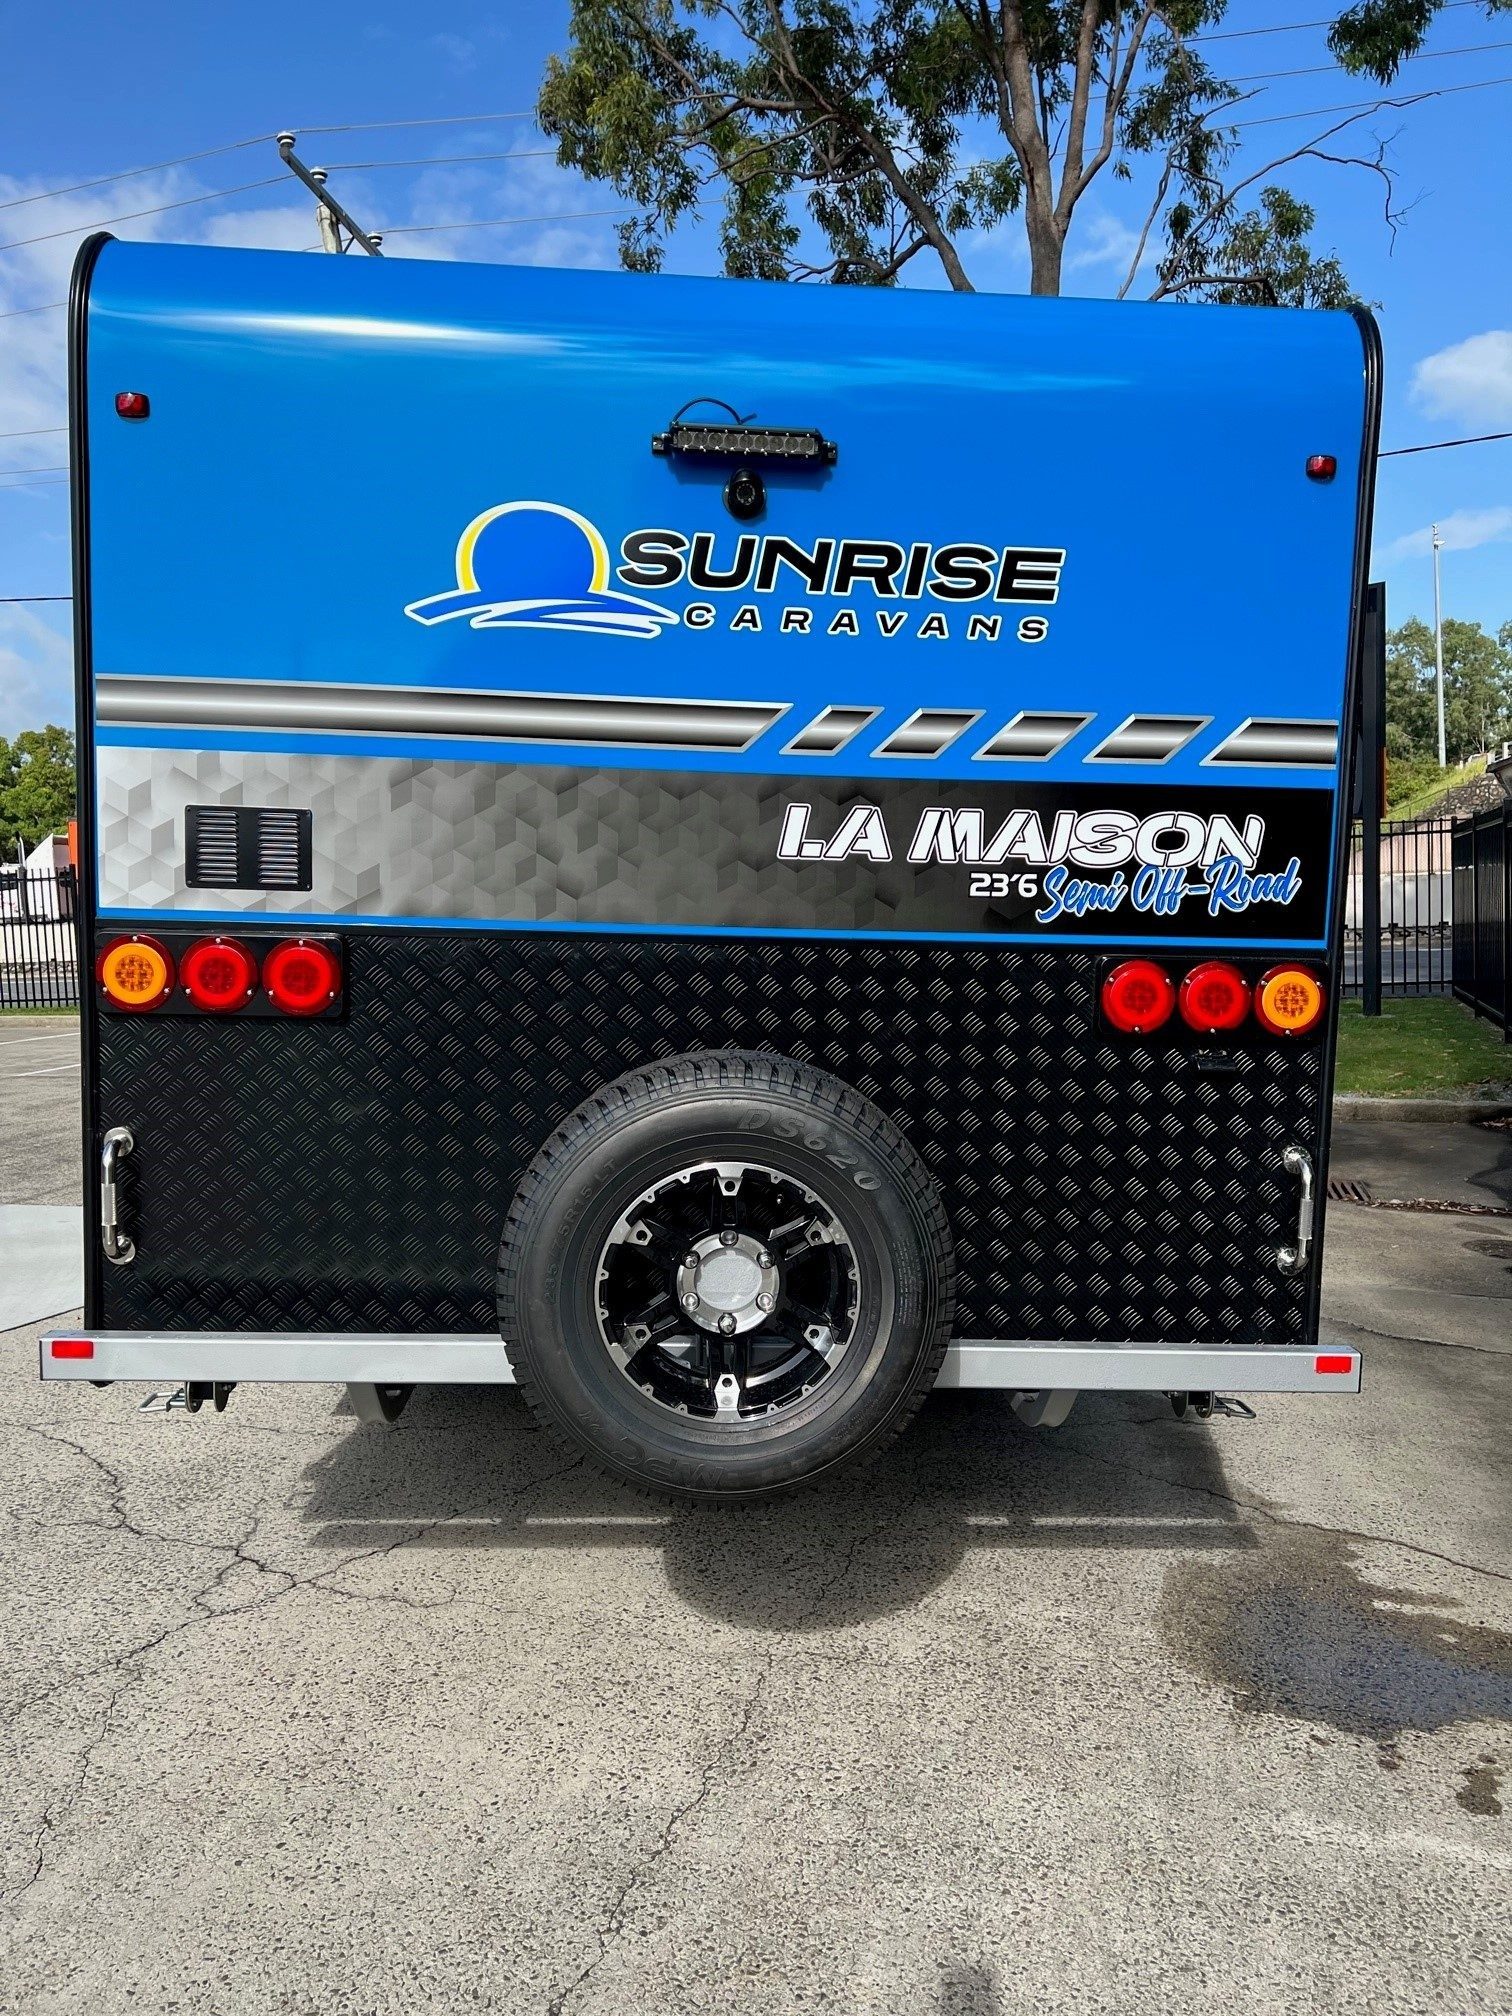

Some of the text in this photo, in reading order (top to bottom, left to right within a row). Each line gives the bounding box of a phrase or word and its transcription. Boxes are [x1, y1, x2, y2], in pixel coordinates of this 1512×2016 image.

[617, 529, 1066, 603] SUNRISE
[683, 602, 1049, 643] CARAVANS
[777, 803, 1266, 869] LA MAISON
[1035, 865, 1127, 923] Semi
[1129, 854, 1301, 917] Off-Road
[737, 1109, 882, 1191] DS620
